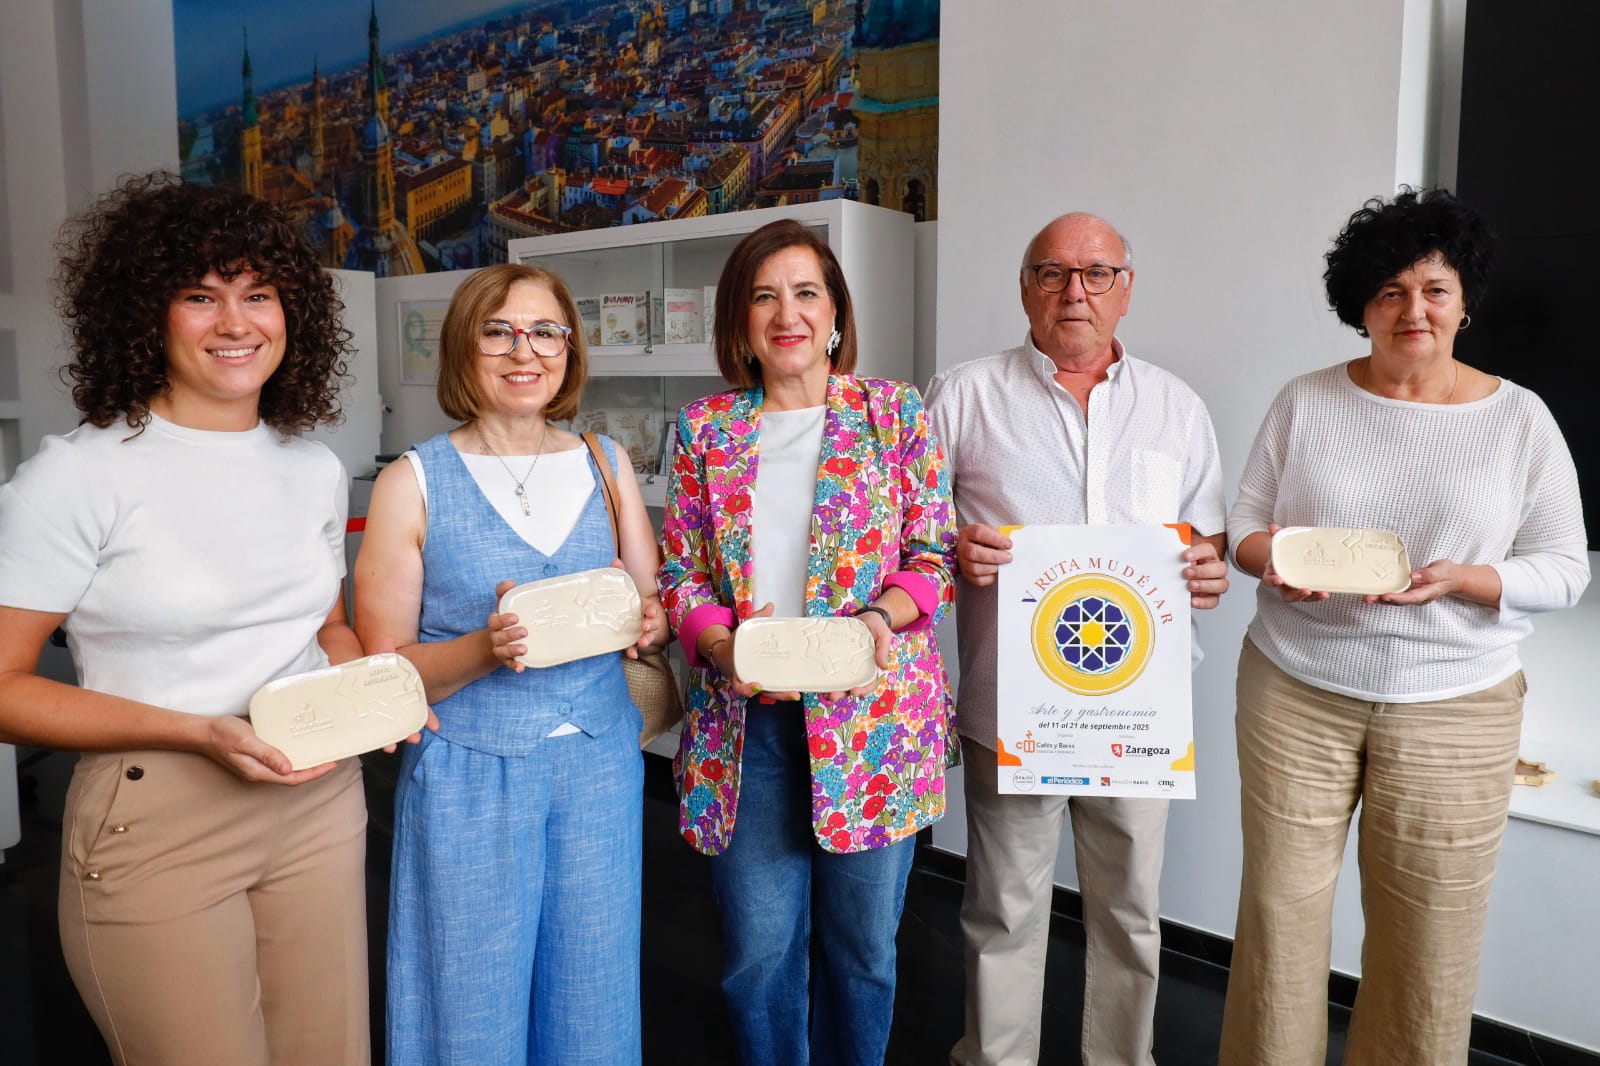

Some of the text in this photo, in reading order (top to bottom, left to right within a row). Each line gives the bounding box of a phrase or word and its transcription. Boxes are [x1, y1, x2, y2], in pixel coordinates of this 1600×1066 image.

[1035, 558, 1081, 591] RUTA
[1088, 557, 1173, 625] MUDÉJAR
[1029, 702, 1158, 722] Arte y gastronomía
[1038, 721, 1050, 729] del
[1080, 722, 1089, 730] de
[1090, 722, 1131, 731] septiembre
[1132, 723, 1150, 731] 2025
[1125, 744, 1170, 757] Zaragoza
[1158, 779, 1175, 787] cmg
